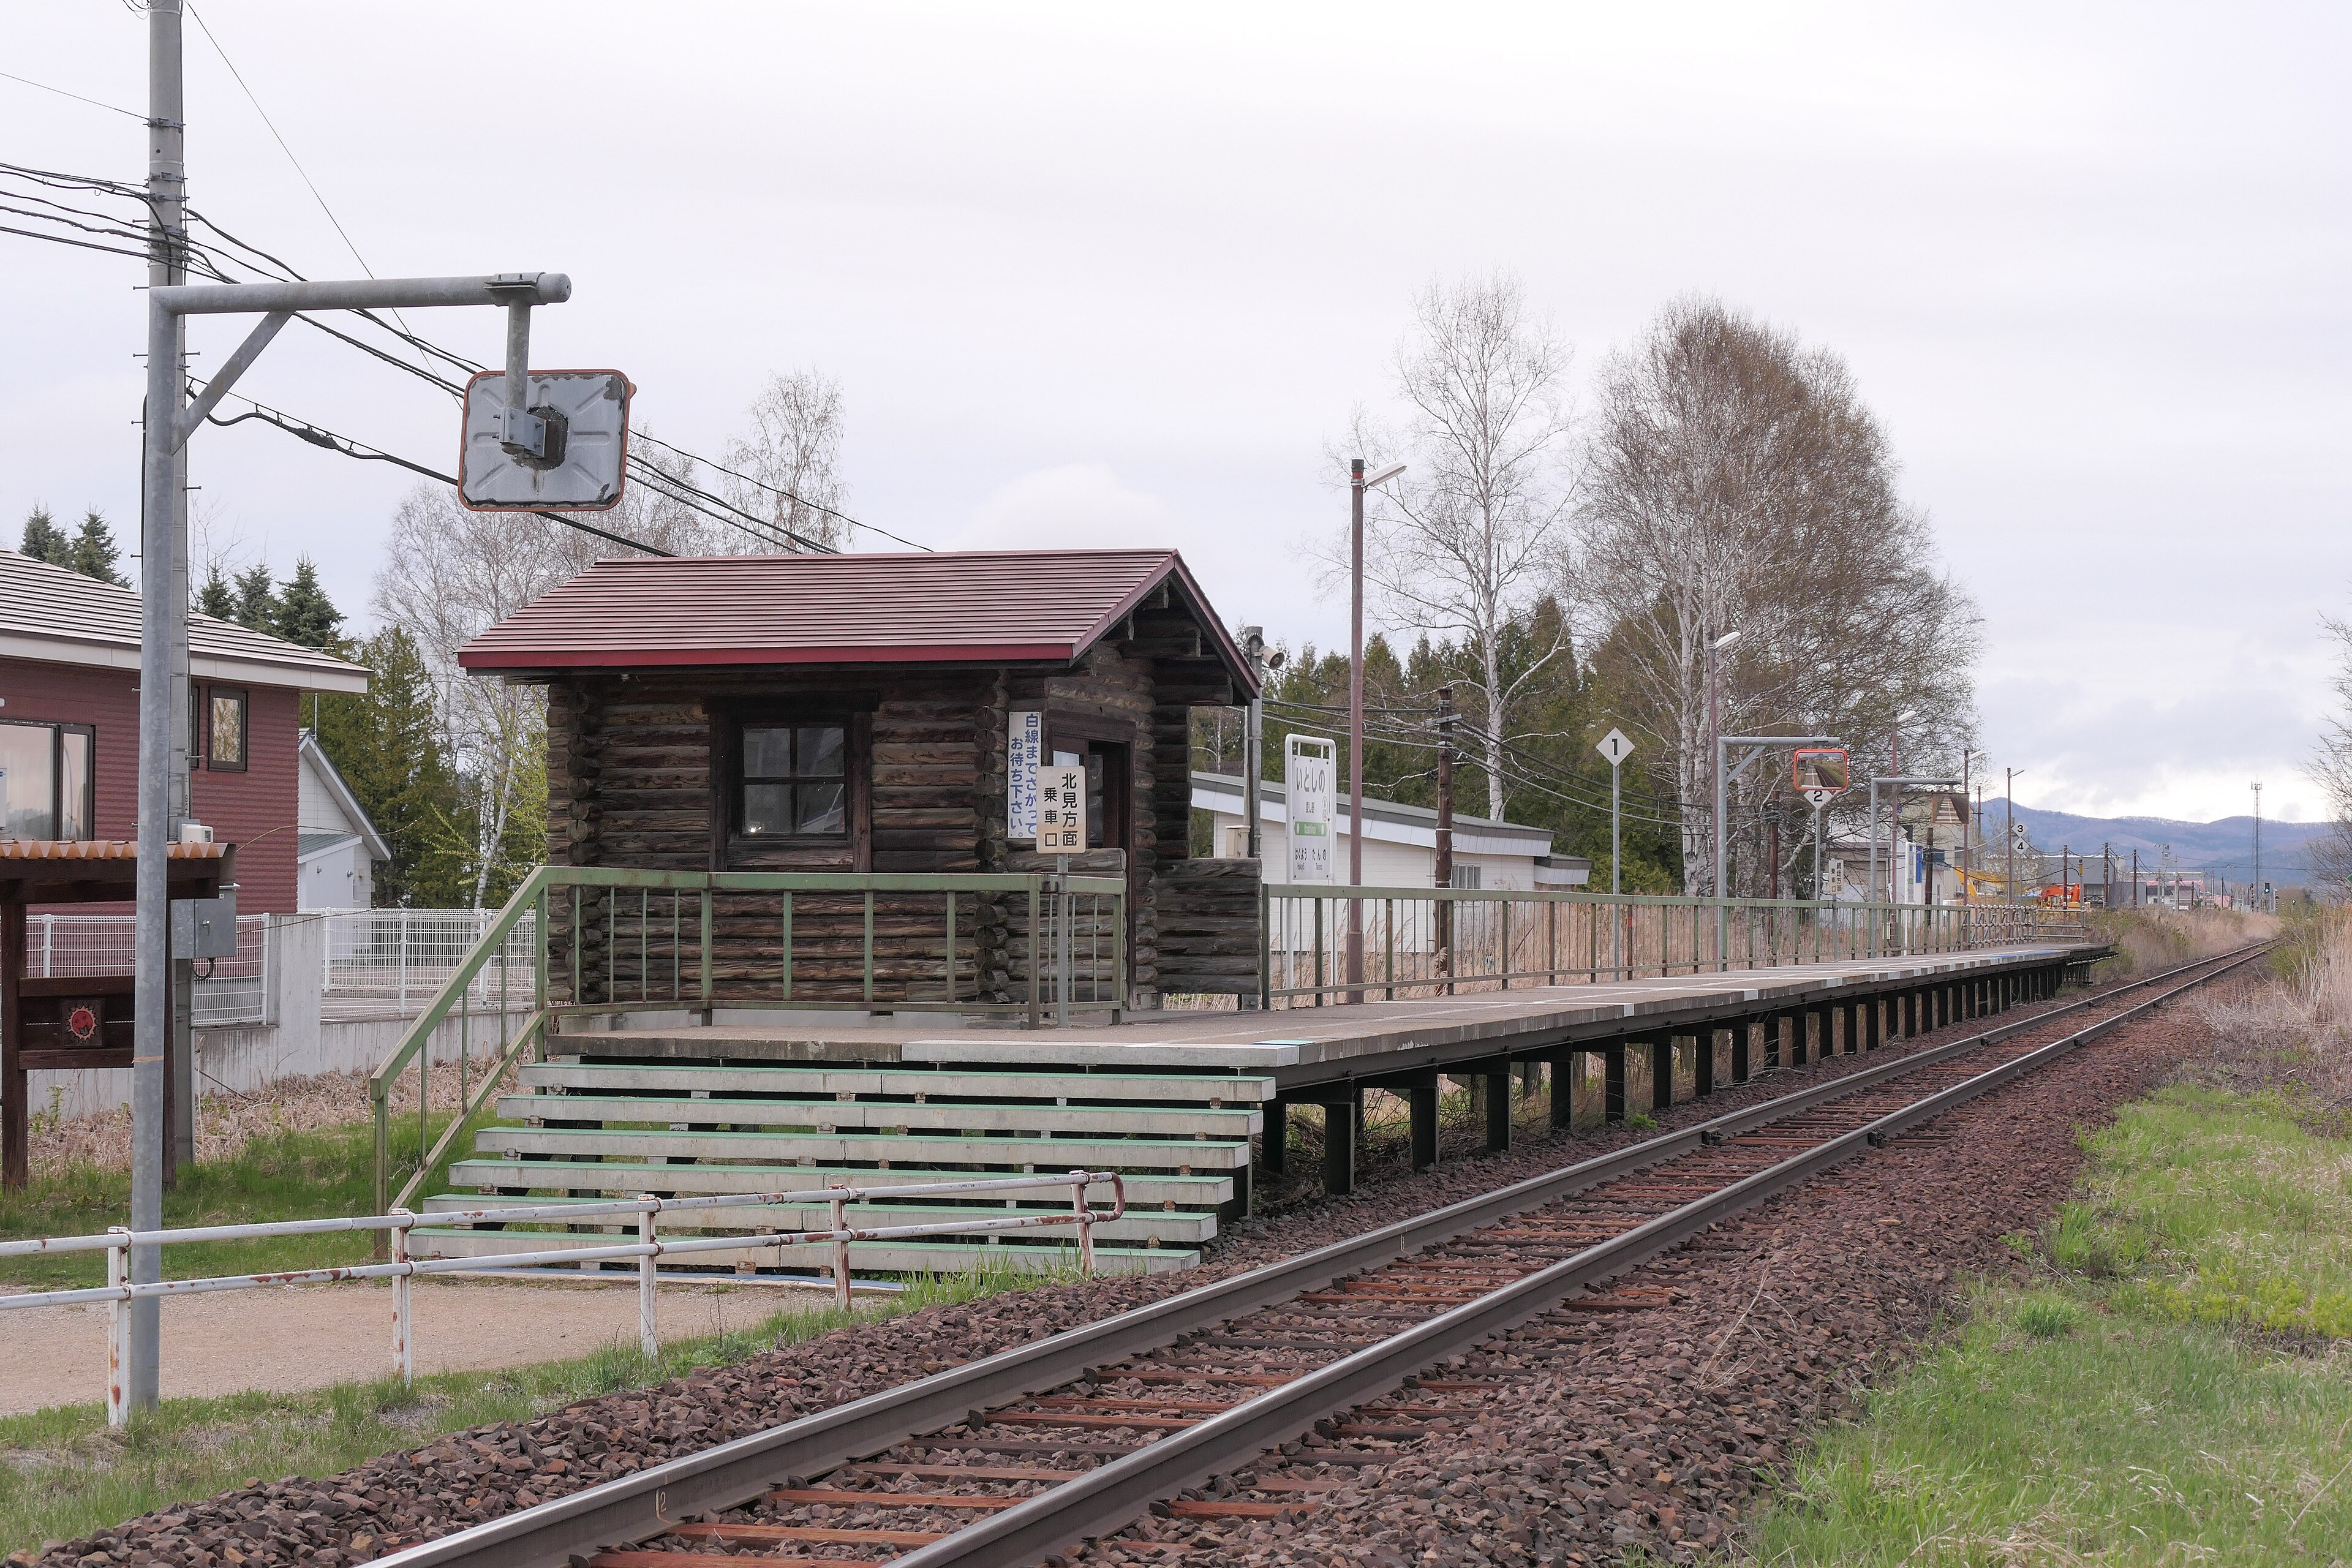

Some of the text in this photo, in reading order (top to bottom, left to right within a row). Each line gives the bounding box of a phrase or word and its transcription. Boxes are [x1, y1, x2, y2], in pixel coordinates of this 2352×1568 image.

[1611, 738, 1618, 756] 1
[1009, 737, 1024, 837] お待ち下さい。
[1025, 714, 1039, 835] 白線までさがって
[1297, 767, 1325, 794] いとしの
[1814, 790, 1823, 802] 2
[1044, 787, 1058, 846] 乗車口
[1061, 773, 1078, 846] 北見方面
[2017, 842, 2024, 850] 4
